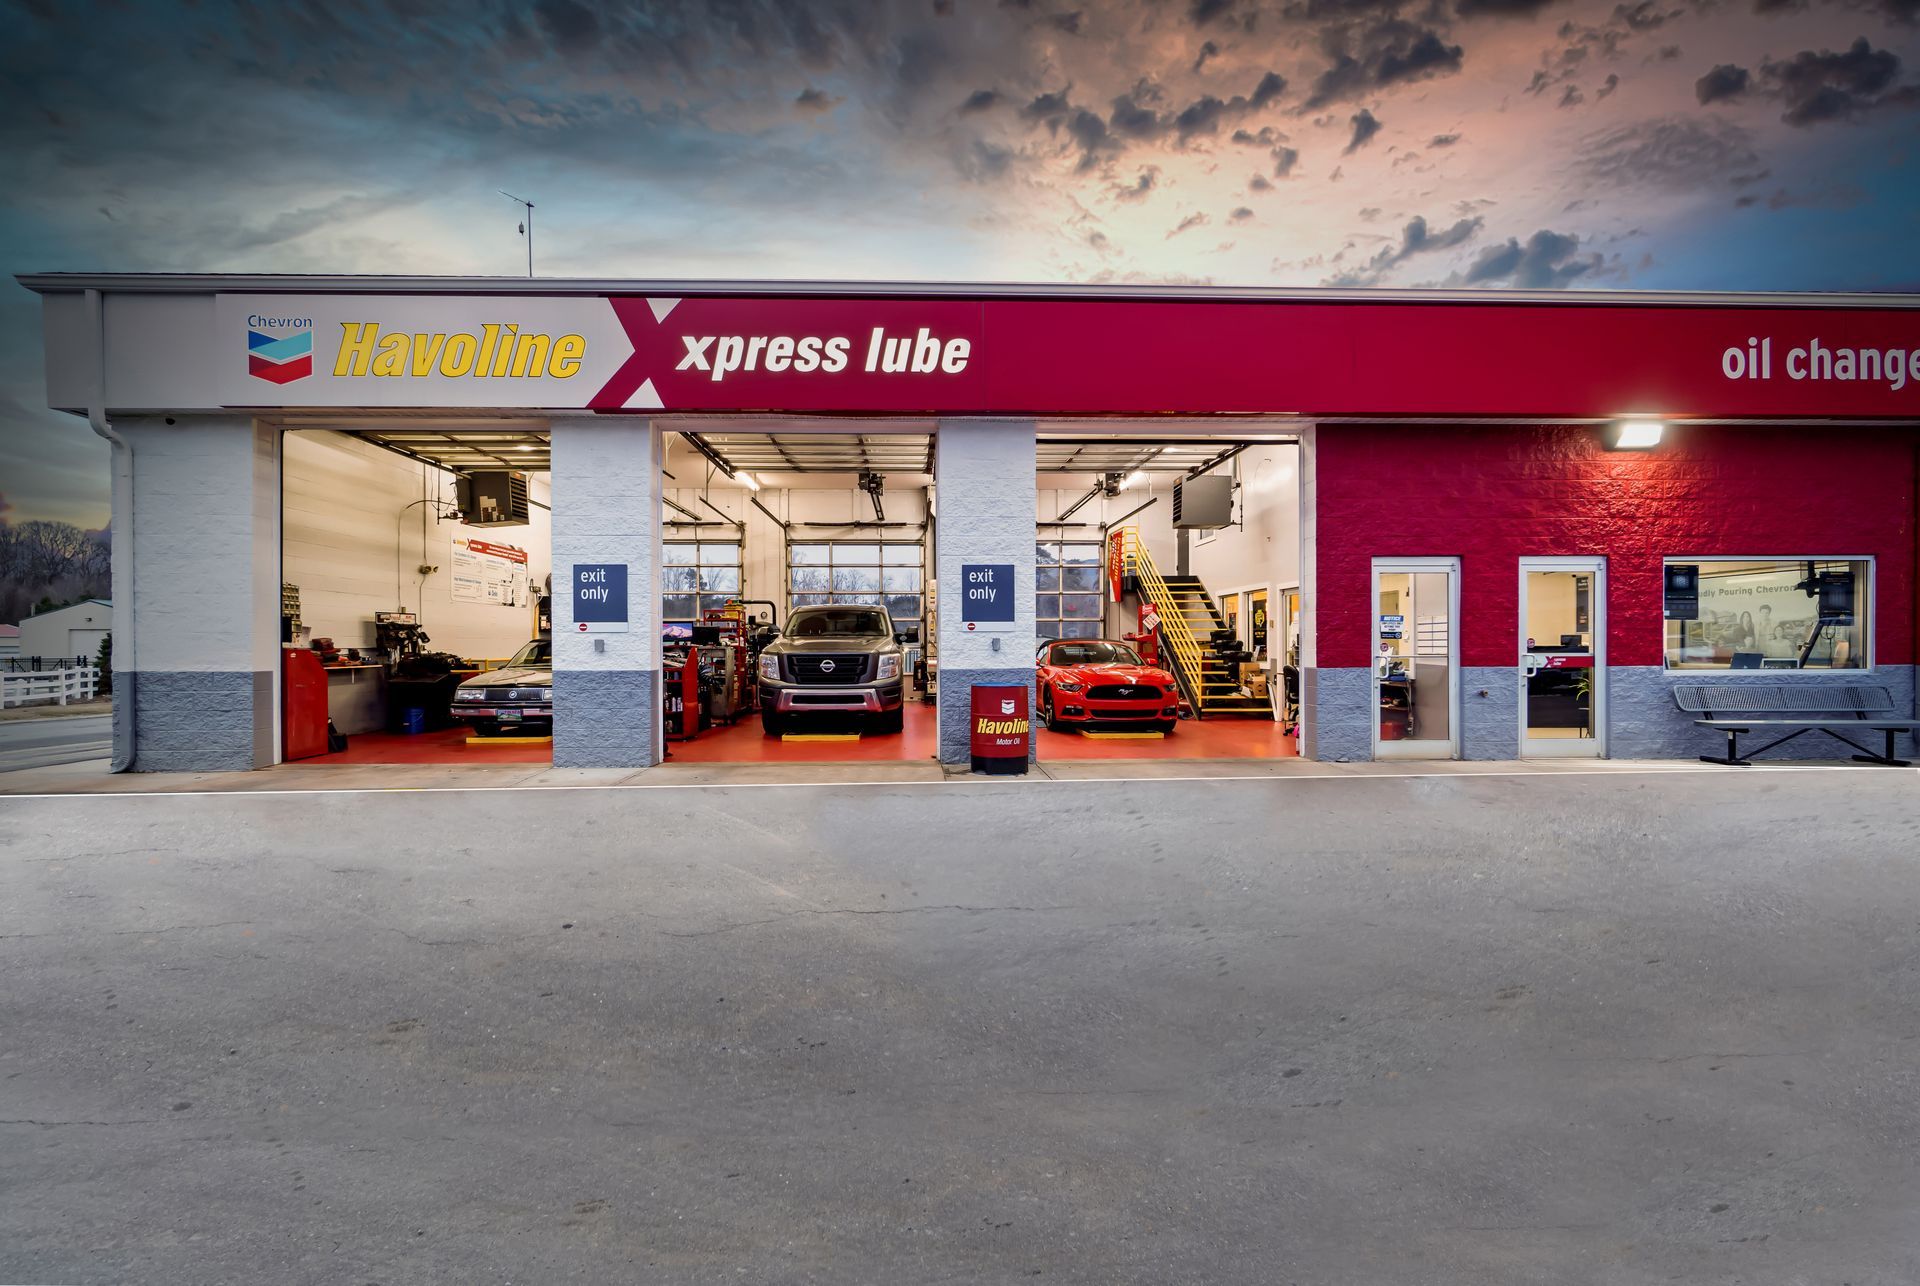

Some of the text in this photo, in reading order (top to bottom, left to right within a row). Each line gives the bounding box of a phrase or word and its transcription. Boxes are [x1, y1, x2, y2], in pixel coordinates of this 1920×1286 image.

[247, 314, 313, 329] Chevron
[333, 322, 586, 378] Havoline
[675, 335, 851, 382] xpress
[864, 327, 971, 374] lube
[1722, 336, 1771, 380] oil
[581, 568, 606, 583] exit
[969, 568, 994, 583] exit
[580, 585, 609, 603] only
[969, 585, 997, 603] only
[1719, 587, 1753, 596] Pouring
[1756, 584, 1796, 594] Chevron
